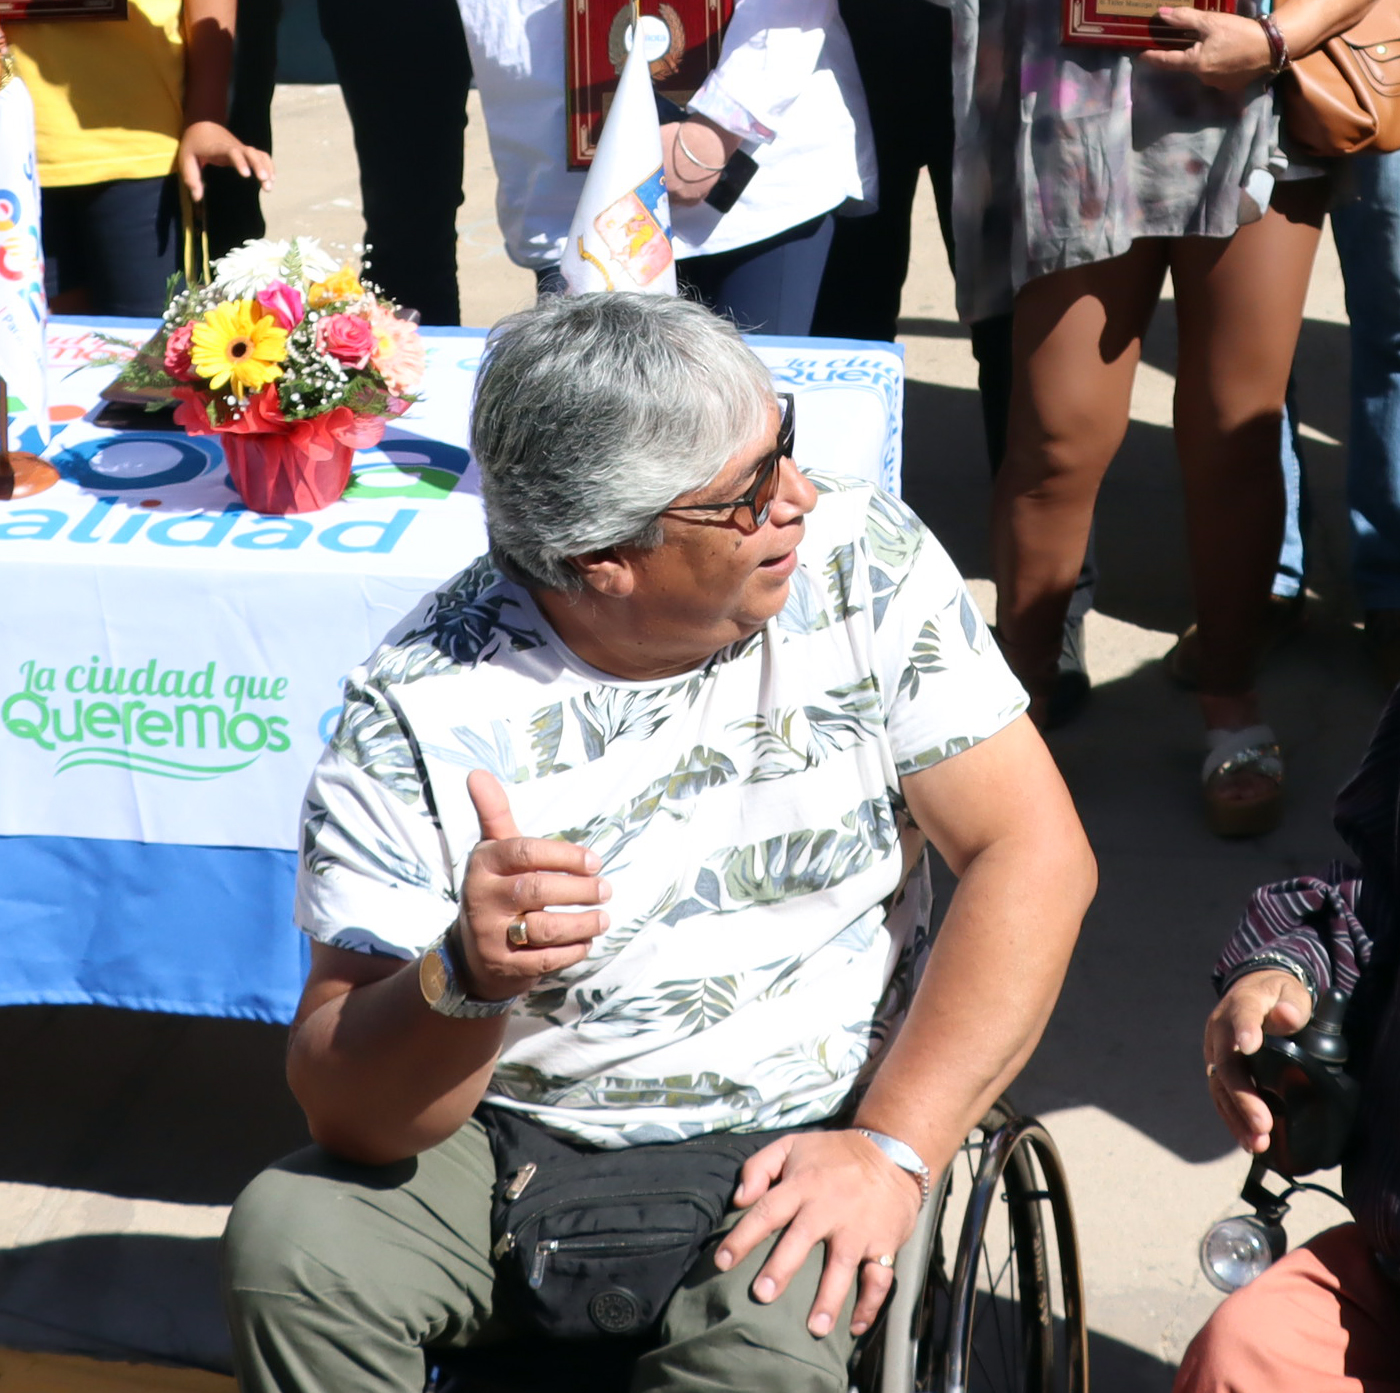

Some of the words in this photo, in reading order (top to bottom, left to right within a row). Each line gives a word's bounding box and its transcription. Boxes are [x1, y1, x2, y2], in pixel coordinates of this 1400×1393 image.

[19, 660, 55, 692] La
[65, 655, 216, 699] ciudad
[224, 674, 289, 713] que
[1, 691, 291, 753] Queremos
